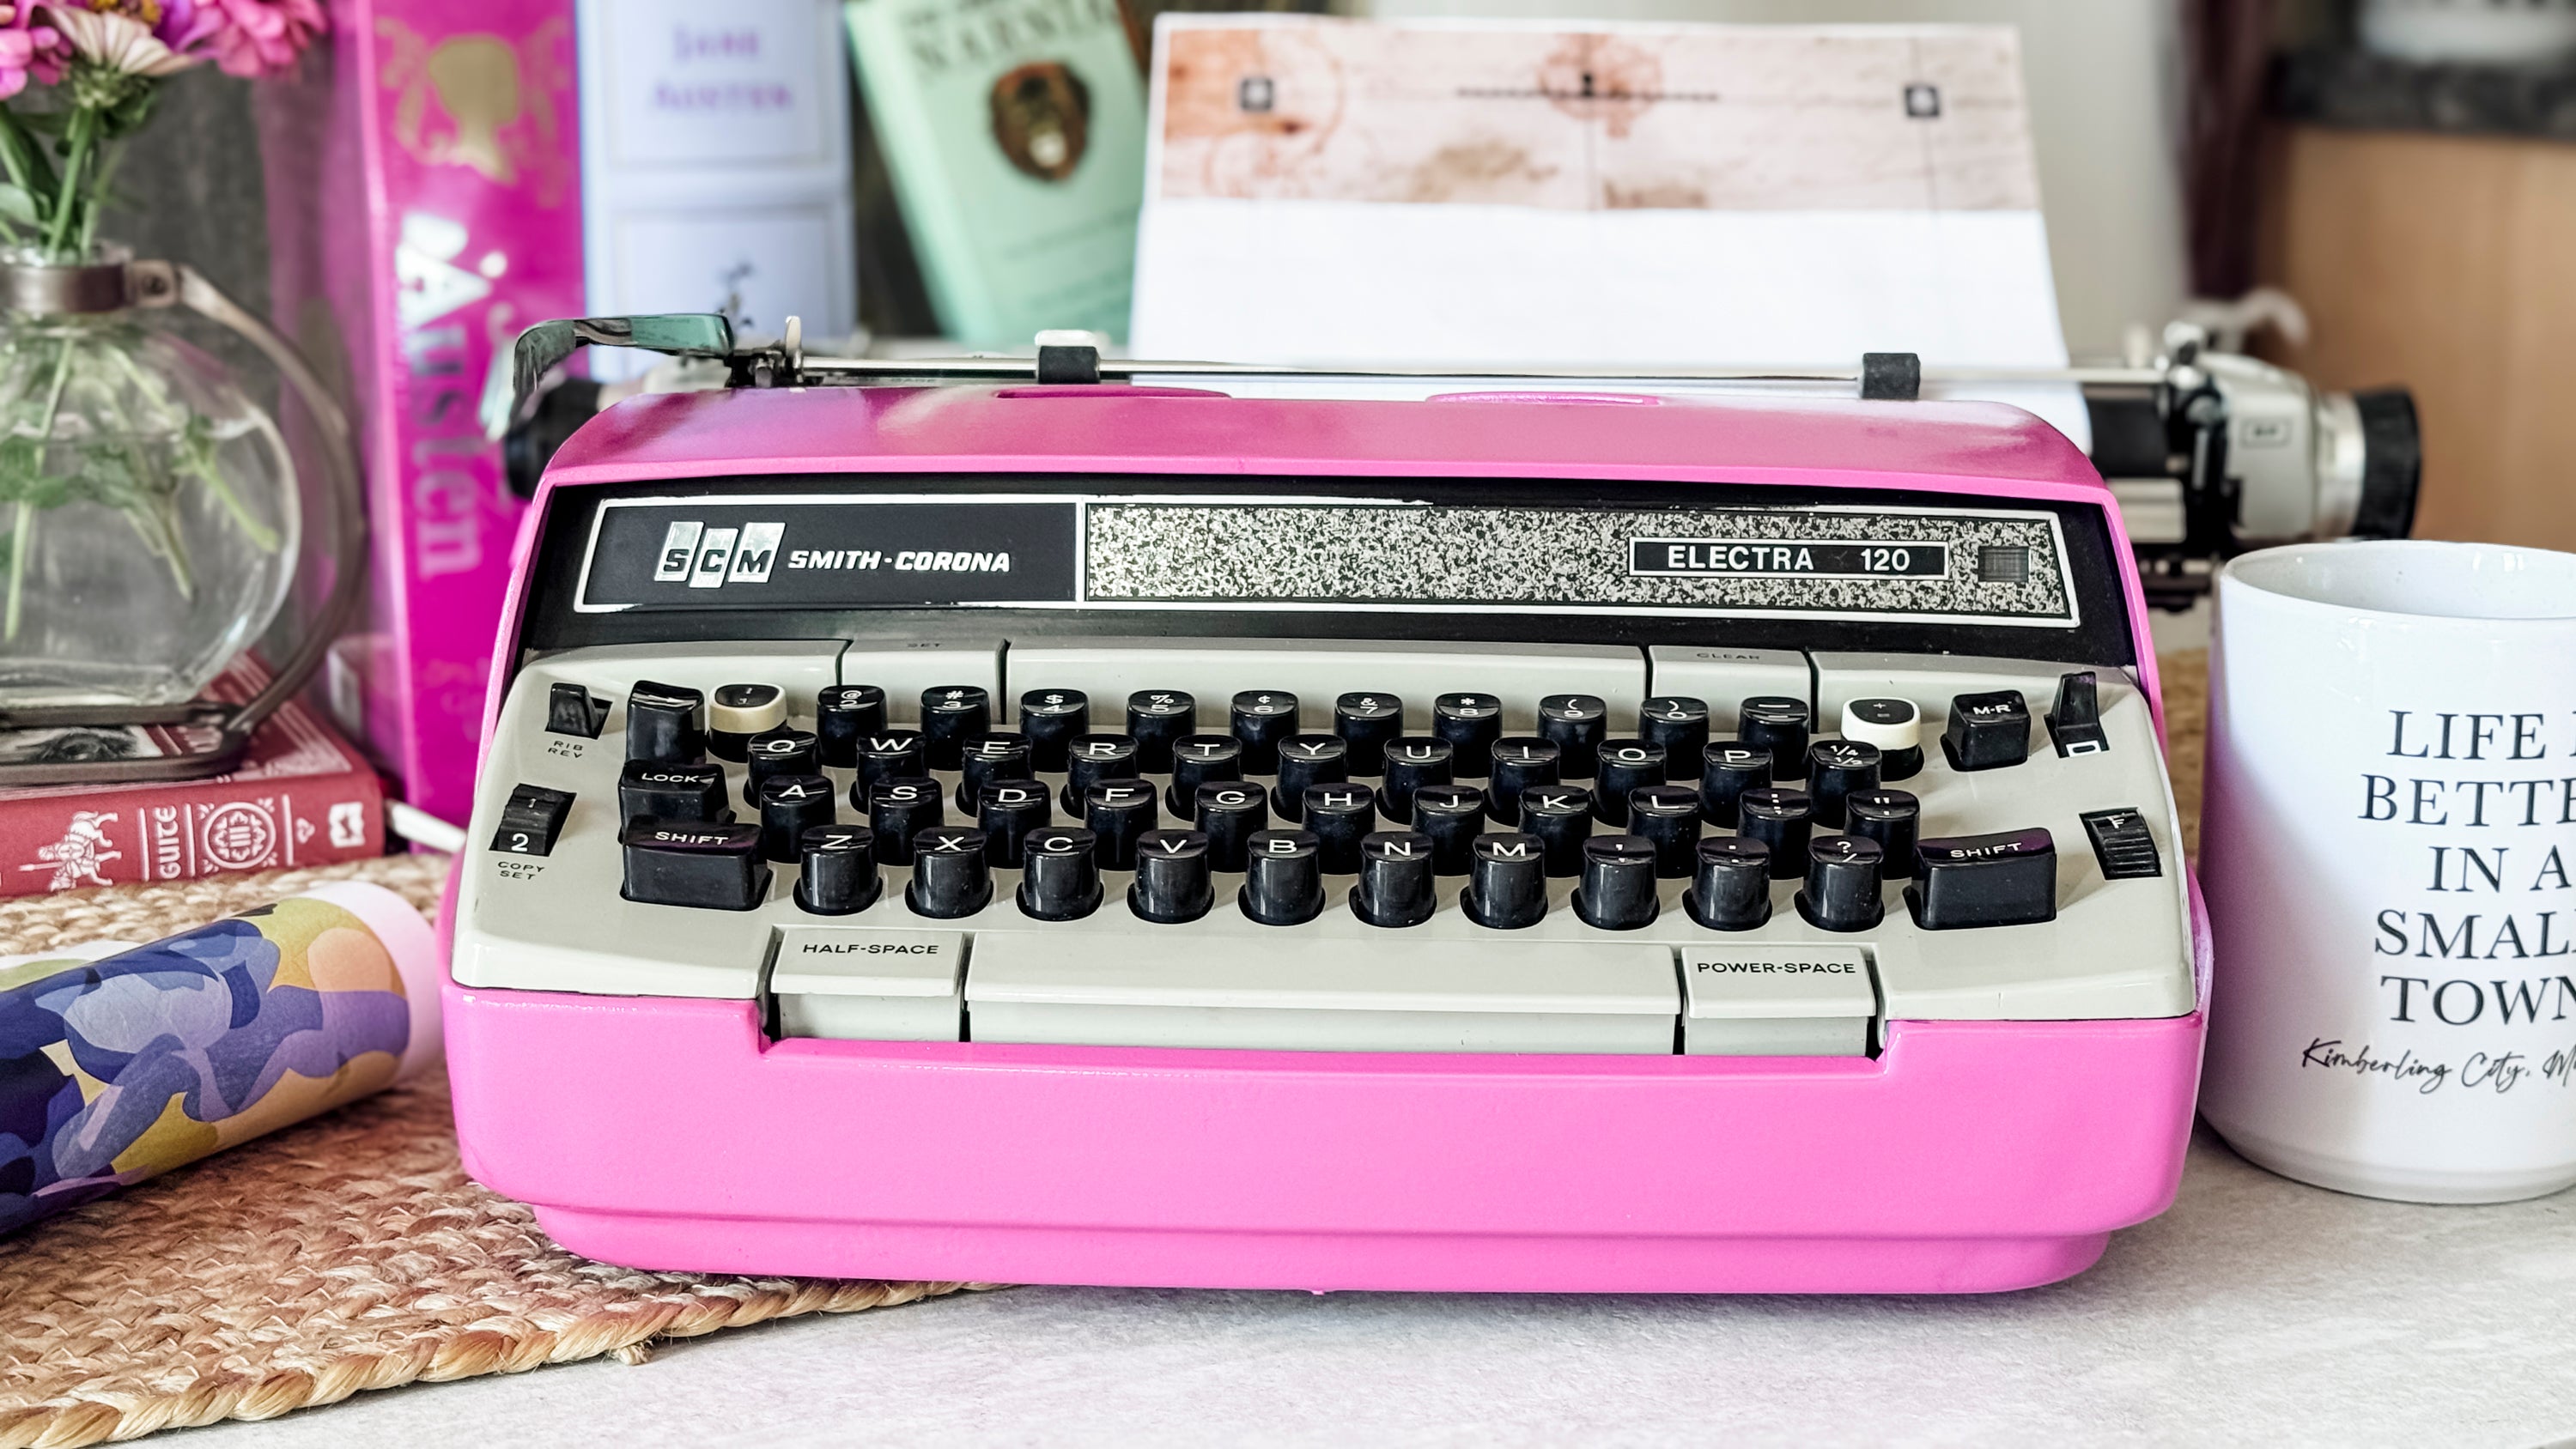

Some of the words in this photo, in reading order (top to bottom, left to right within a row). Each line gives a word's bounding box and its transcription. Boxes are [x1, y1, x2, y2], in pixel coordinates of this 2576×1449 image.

[788, 551, 1009, 572] SMITH-CORONA
[1668, 545, 1814, 570] ELECTRA
[1861, 549, 1910, 572] 120
[1973, 704, 2012, 715] M-R
[2387, 711, 2545, 760] LIFE
[551, 739, 584, 751] RIB
[767, 740, 797, 752] Q
[871, 737, 913, 751] W
[982, 742, 1011, 754] E
[1089, 743, 1117, 755] R
[1194, 743, 1220, 756] T
[1299, 743, 1327, 755] Y
[547, 747, 583, 759] REV
[1406, 746, 1431, 759] U
[1618, 749, 1646, 761] O
[1724, 749, 1752, 762] P
[641, 773, 700, 783] LOCK
[779, 785, 806, 797] A
[890, 786, 917, 800] S
[998, 788, 1027, 803] D
[1105, 788, 1134, 802] F
[1216, 791, 1245, 804] G
[1324, 792, 1352, 806] H
[1439, 795, 1459, 808] J
[1542, 795, 1571, 809] K
[1651, 795, 1680, 808] L
[511, 833, 531, 852] 2
[654, 830, 729, 846] SHIFT
[821, 834, 853, 850] Z
[934, 836, 964, 851] X
[1043, 837, 1073, 852] C
[1159, 839, 1188, 854] V
[1268, 840, 1297, 853] B
[1384, 841, 1411, 856] N
[1492, 842, 1526, 857] M
[1949, 842, 2022, 858] SHIFT
[497, 861, 545, 871] COPY
[2427, 846, 2508, 892] IN
[2530, 845, 2572, 890] A
[500, 870, 537, 880] SET
[2375, 909, 2576, 959] SMAL
[803, 944, 939, 954] HALF-SPACE
[1698, 963, 1855, 973] POWER-SPACE
[2302, 1038, 2452, 1094] Kimberling
